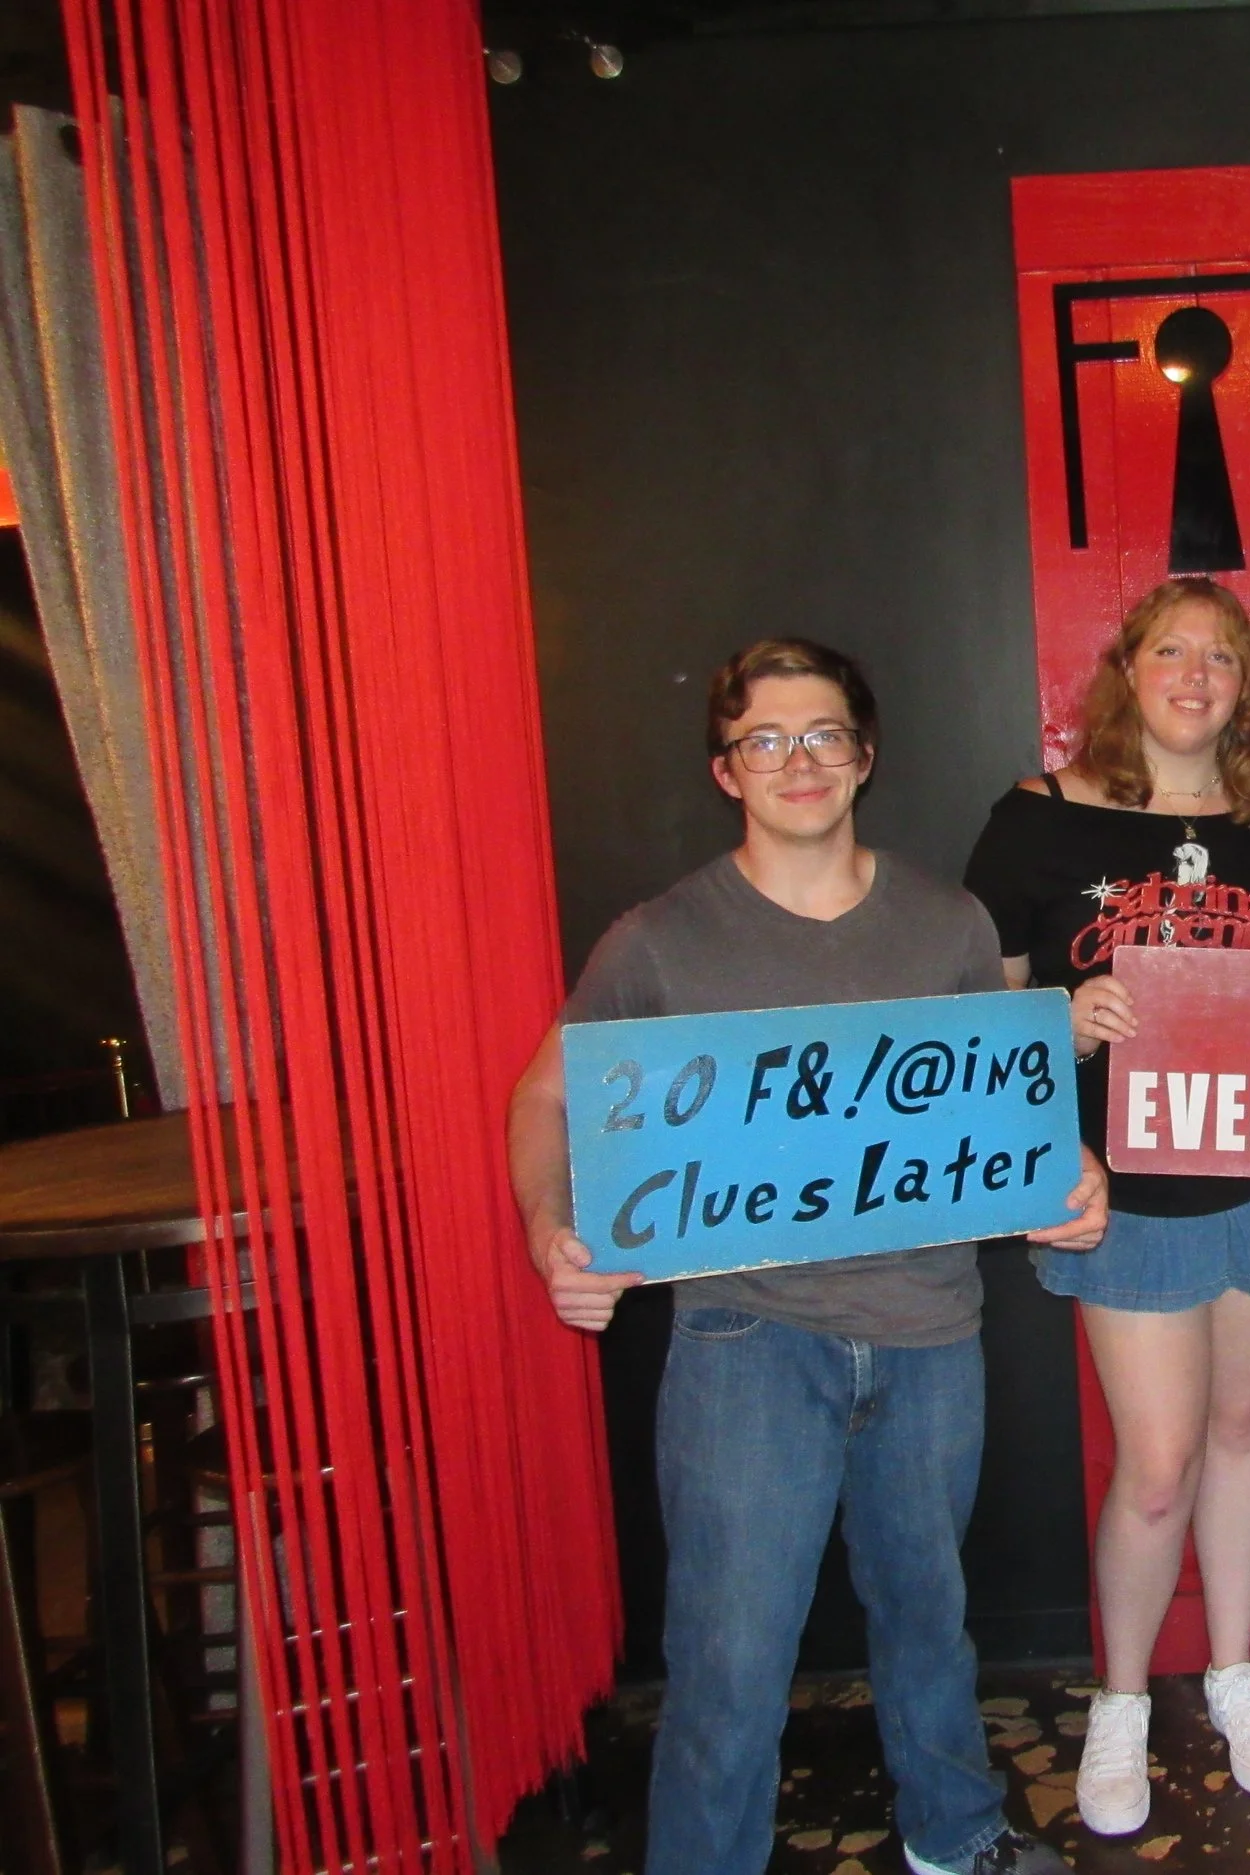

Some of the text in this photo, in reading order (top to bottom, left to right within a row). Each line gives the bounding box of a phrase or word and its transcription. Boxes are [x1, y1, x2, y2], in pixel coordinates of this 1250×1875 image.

[601, 1058, 718, 1133] 20
[611, 1135, 1052, 1249] Clues Later
